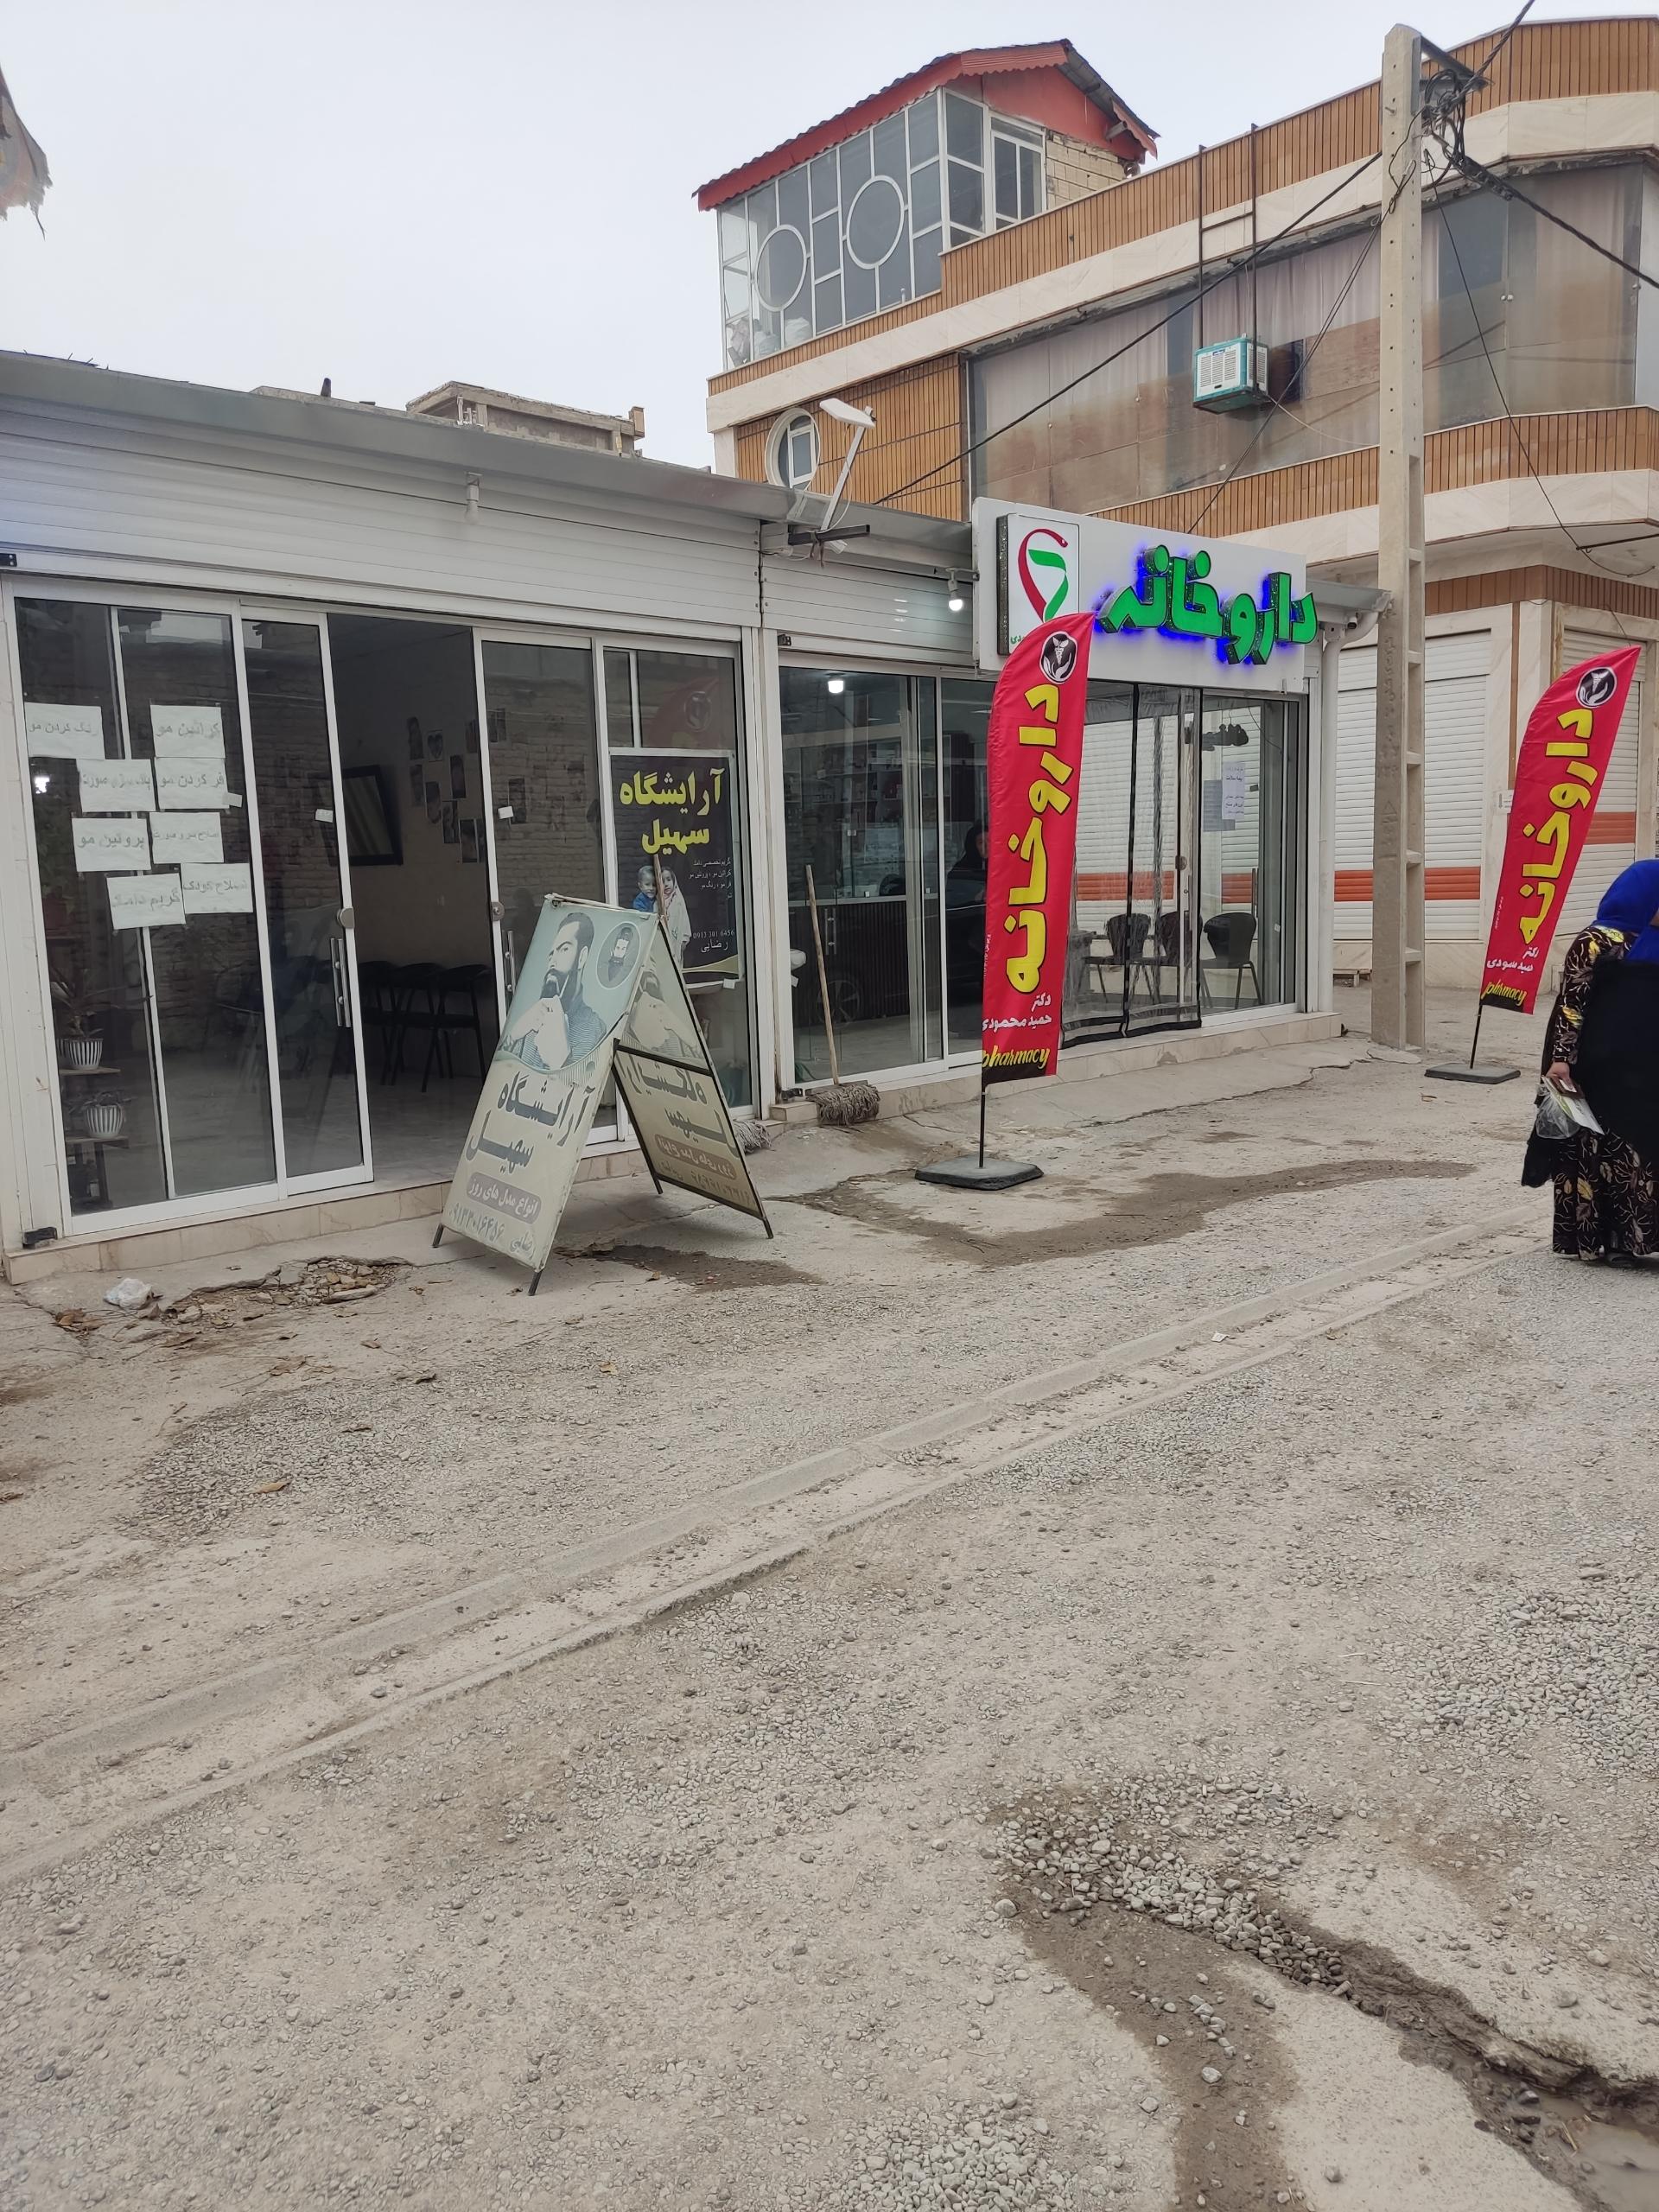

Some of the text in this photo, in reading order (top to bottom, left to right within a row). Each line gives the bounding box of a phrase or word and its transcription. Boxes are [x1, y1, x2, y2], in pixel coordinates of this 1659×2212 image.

[1096, 544, 1318, 664] داروخانه
[29, 723, 42, 733] مو
[156, 725, 173, 737] مو
[159, 777, 176, 787] مو
[178, 773, 207, 788] کردن
[620, 768, 725, 816] آرایشگاه
[1519, 708, 1599, 944] داروخانه
[77, 836, 95, 849] مو
[641, 818, 709, 855] سهیل
[1005, 683, 1073, 994] داروخانه
[701, 938, 728, 953] رضایی
[1031, 992, 1052, 1012] دکتر
[1027, 1014, 1052, 1030] حمید
[497, 1071, 596, 1147] آرایشگاه
[465, 1109, 535, 1174] سهیل
[467, 1178, 483, 1197] روز
[498, 1188, 516, 1206] مدل
[517, 1200, 539, 1219] انواع
